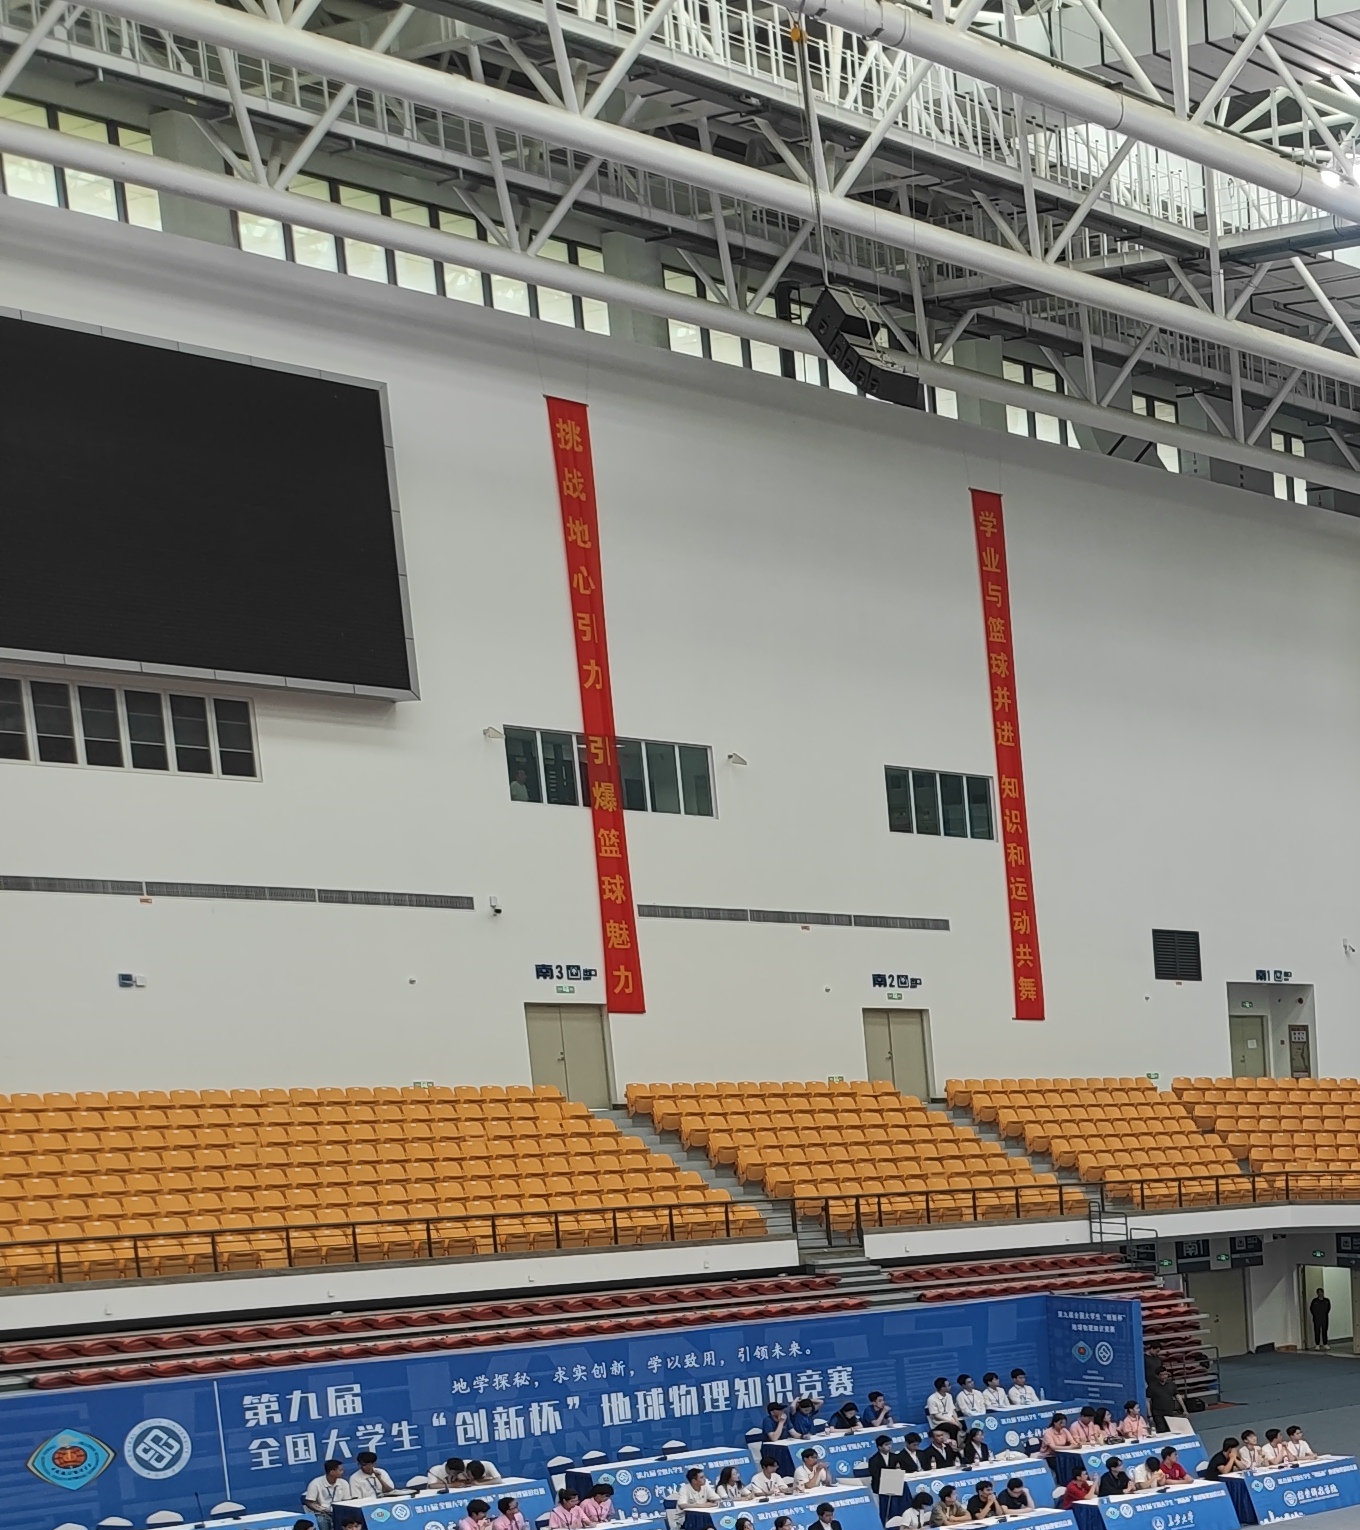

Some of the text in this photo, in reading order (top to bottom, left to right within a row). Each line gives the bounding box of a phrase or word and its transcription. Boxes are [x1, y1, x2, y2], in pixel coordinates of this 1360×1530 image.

[554, 416, 636, 996] 挑战地心引力 引爆篮球魅力
[977, 510, 1038, 1002] 学业与篮球并进 知识和运动共舞
[535, 964, 564, 980] 南3
[242, 1383, 364, 1428] 第九届
